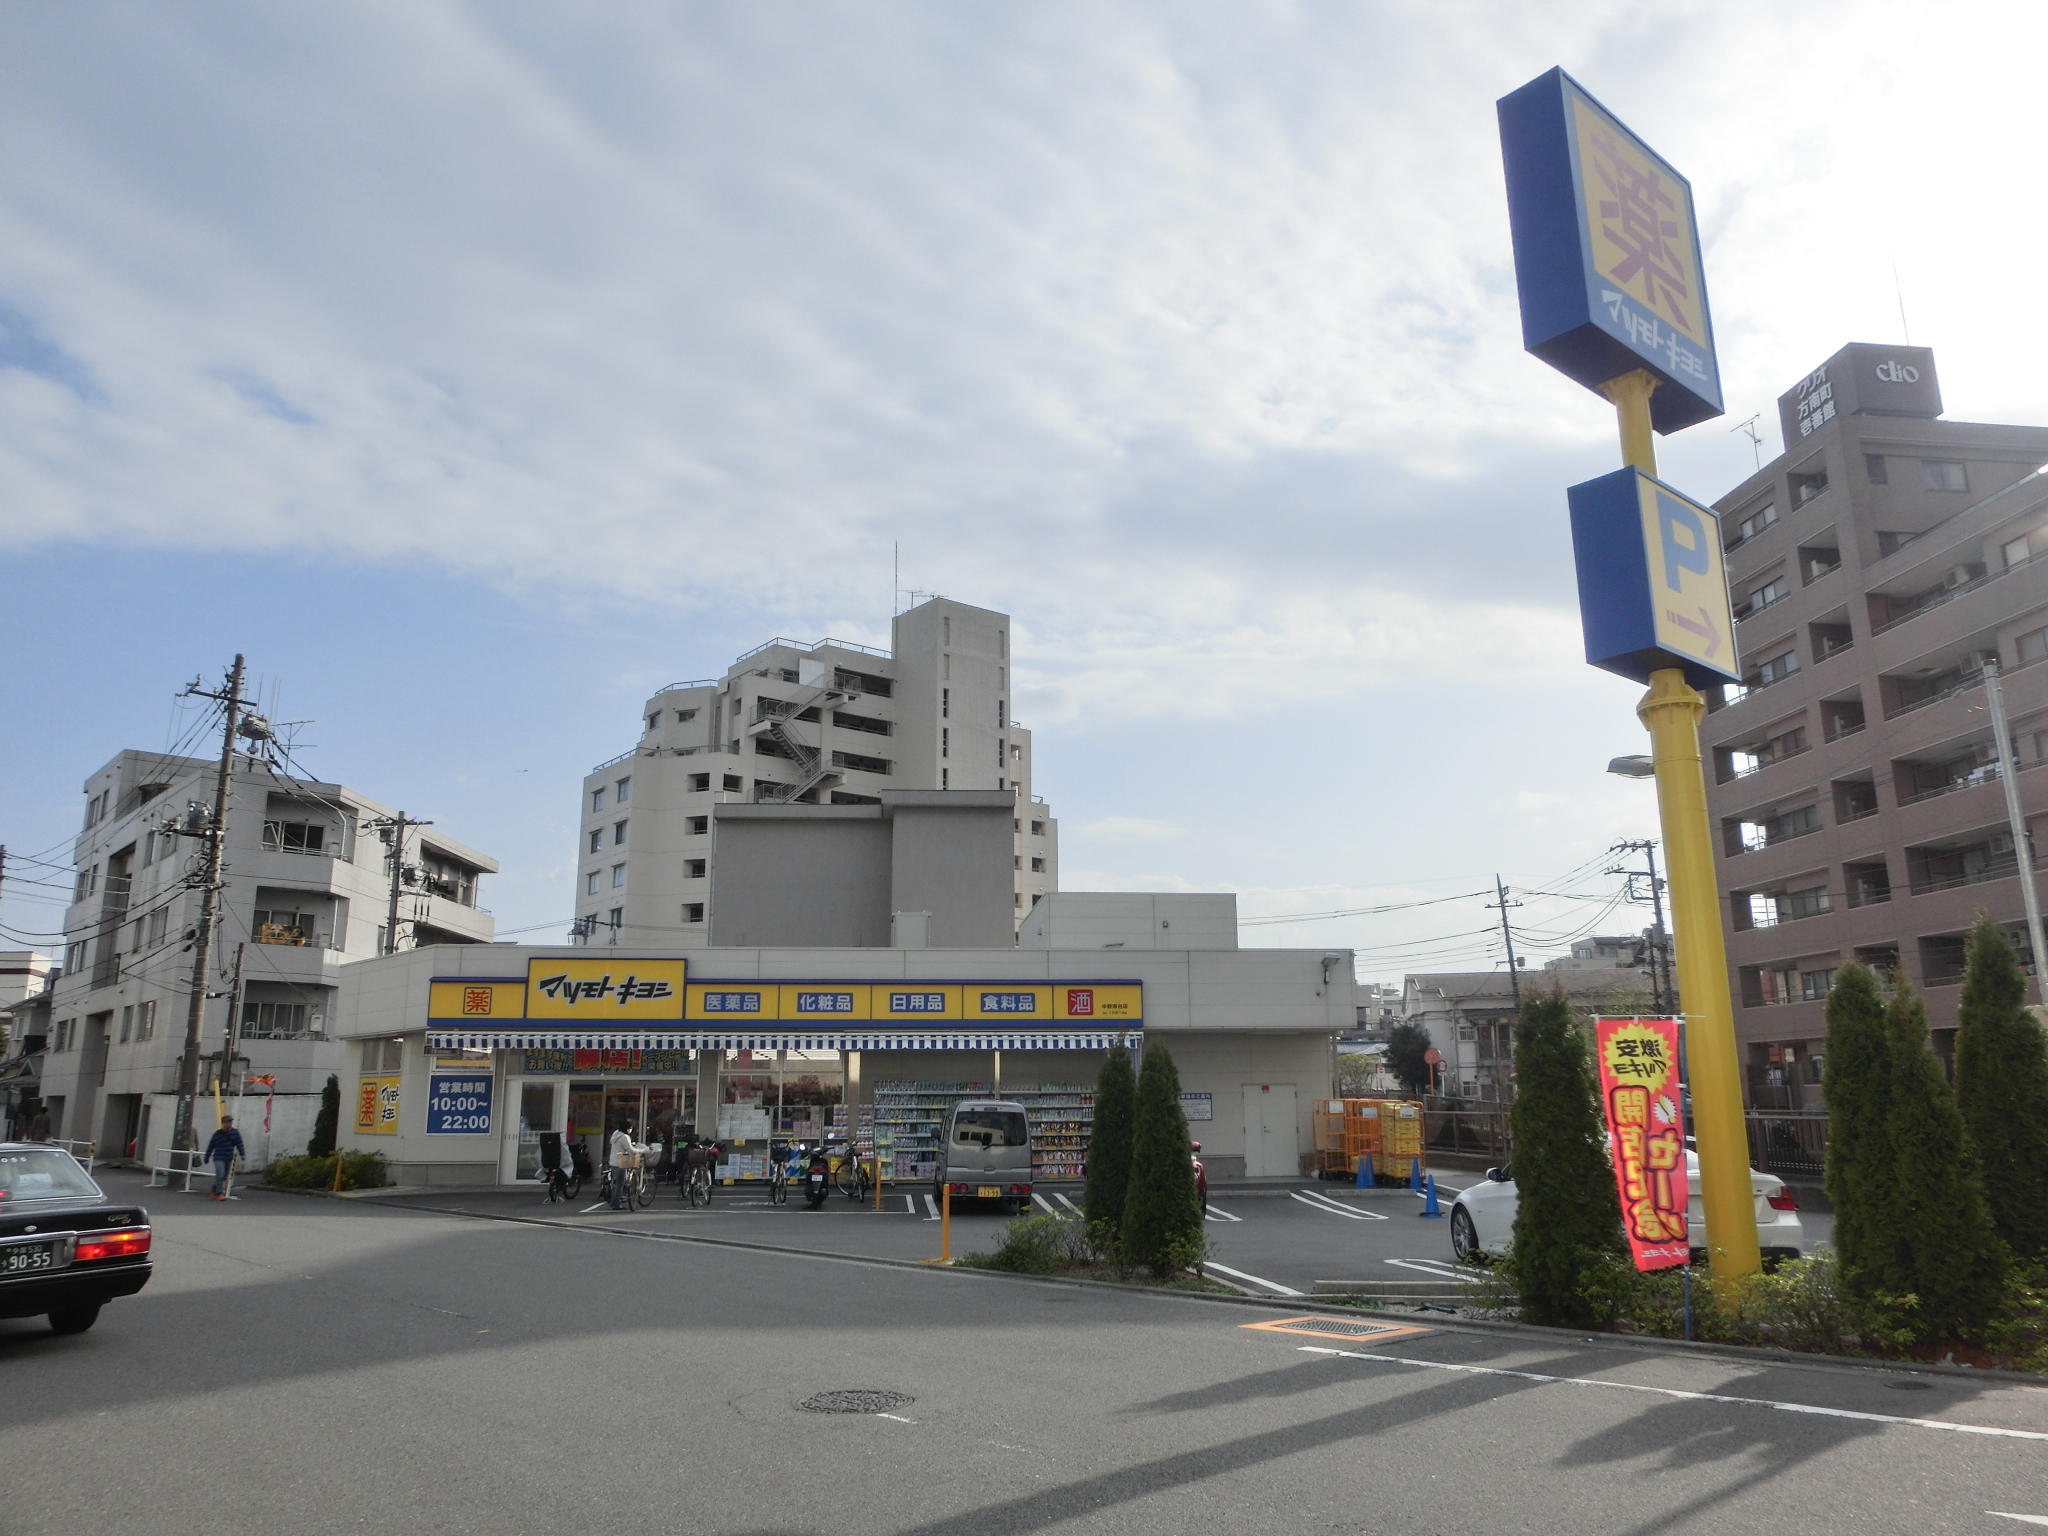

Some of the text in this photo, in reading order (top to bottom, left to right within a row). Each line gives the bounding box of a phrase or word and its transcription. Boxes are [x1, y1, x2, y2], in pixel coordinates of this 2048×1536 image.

[1589, 128, 1692, 333] 薬
[1601, 289, 1708, 381] マツモトキヨシ
[1797, 365, 1828, 399] クリオ
[1797, 382, 1833, 420] 方南町
[1655, 489, 1709, 595] P
[538, 973, 674, 1006] マツモトキヨシ
[467, 989, 490, 1013] 薬
[705, 994, 759, 1011] 医薬品
[799, 994, 852, 1011] 化粧品
[891, 994, 943, 1011] 日用品
[982, 994, 1034, 1011] 食料品
[1069, 992, 1091, 1013] 酒
[439, 1082, 486, 1094] 営業時間
[361, 1087, 375, 1122] 薬
[441, 1116, 490, 1130] 22:00
[9, 1252, 51, 1269] 90-55
